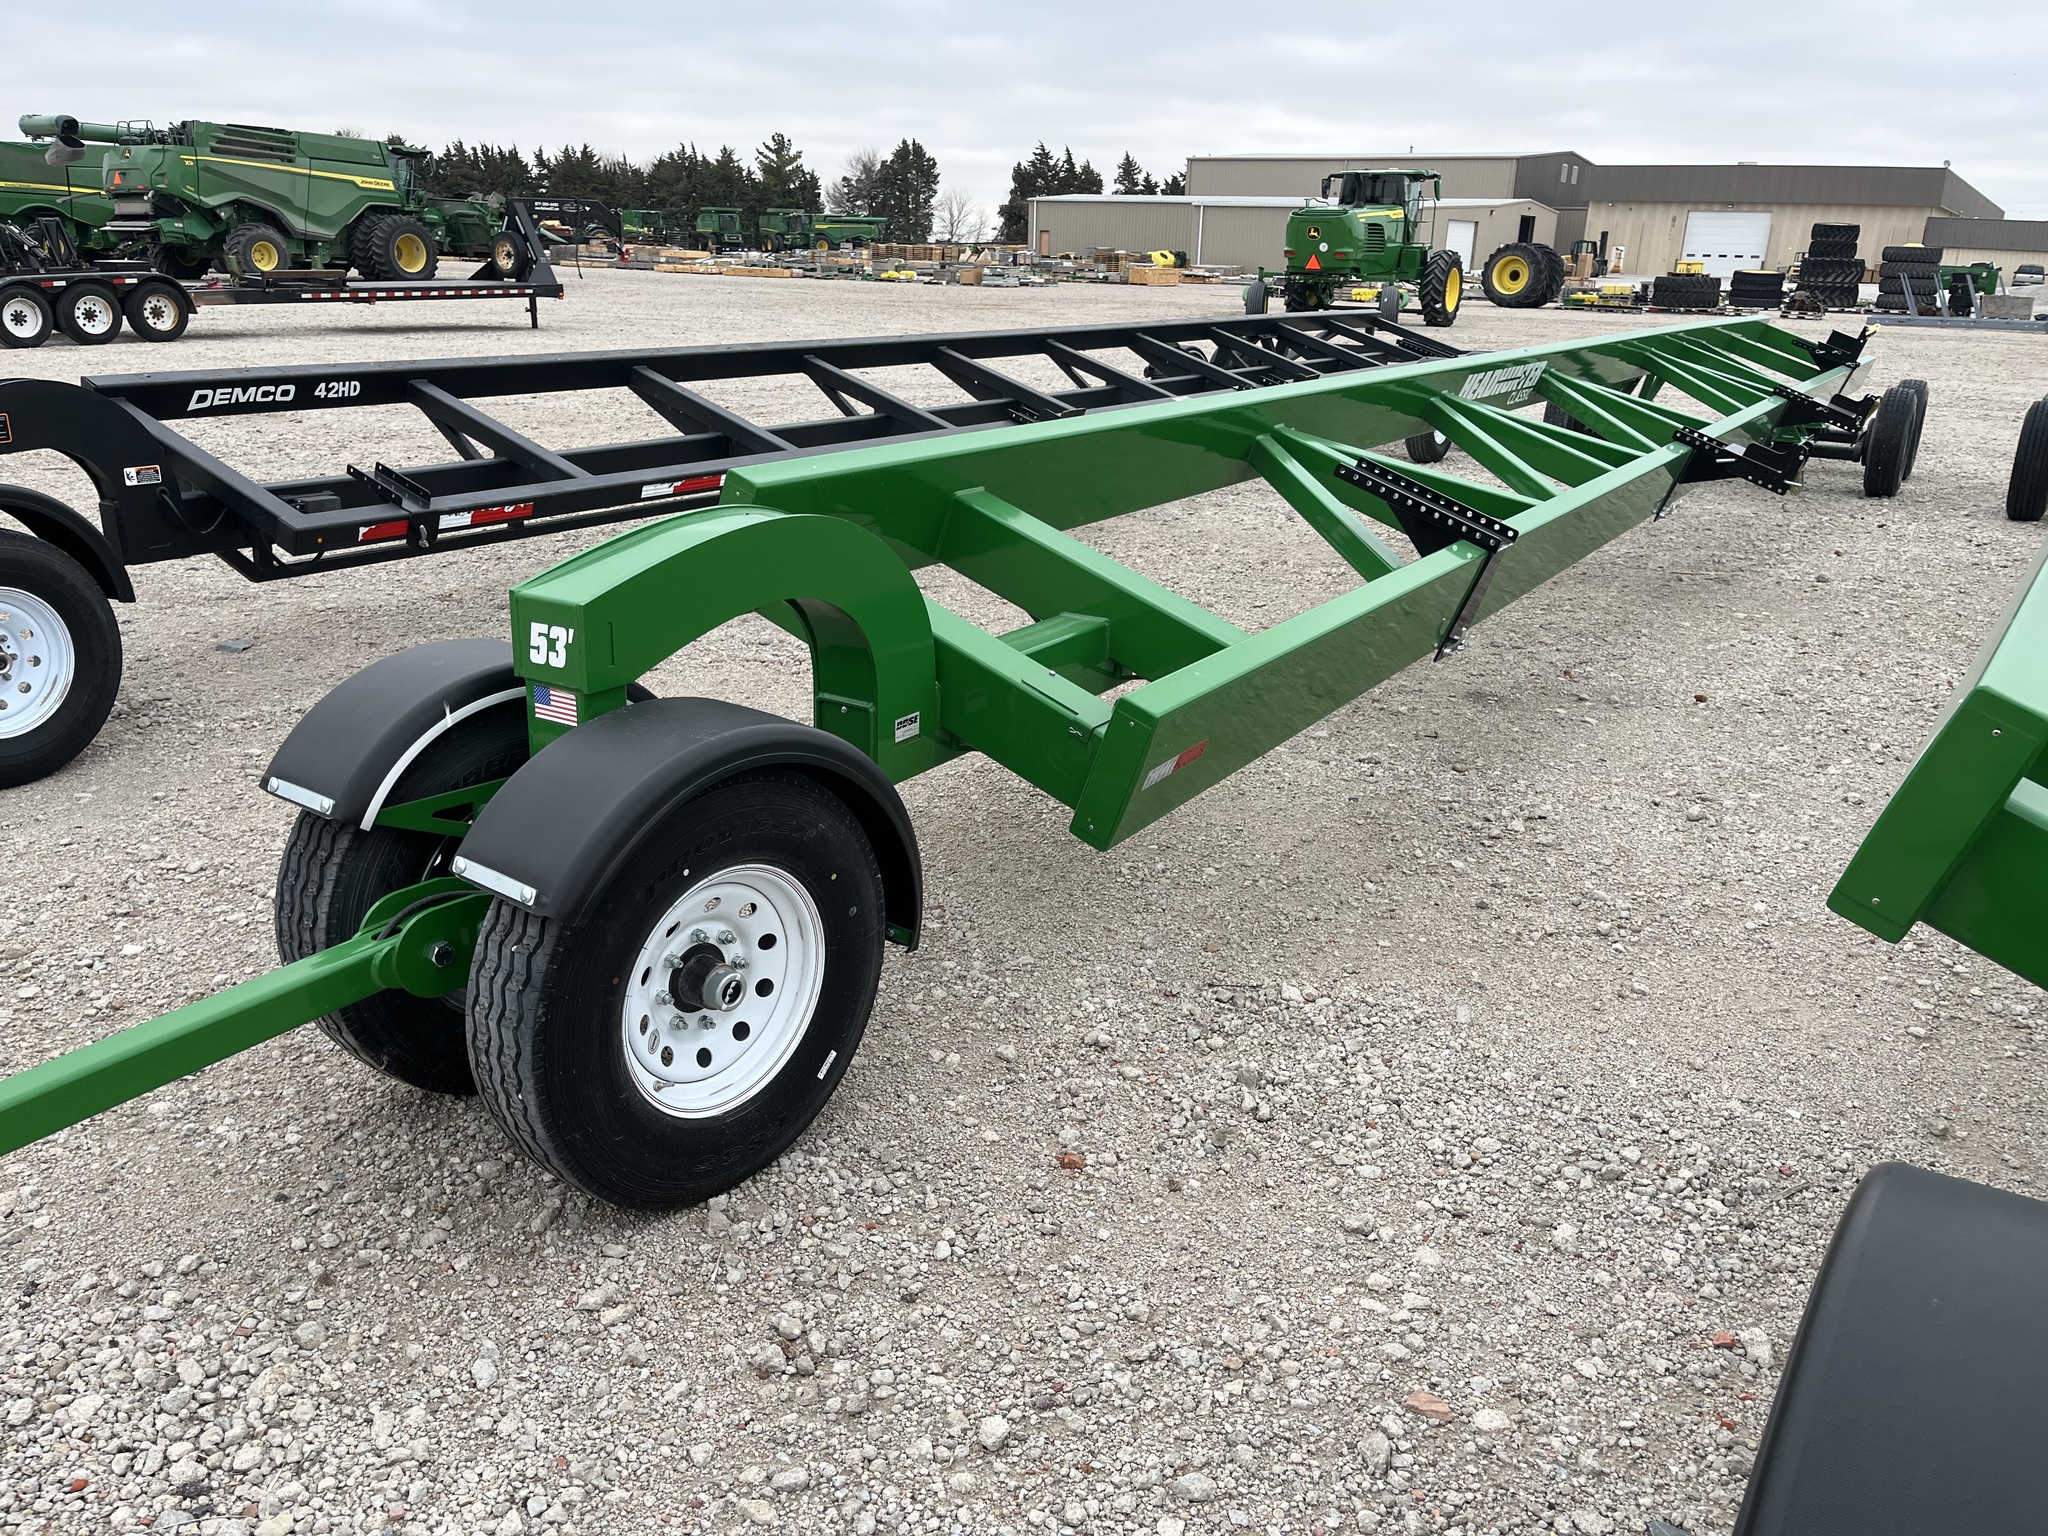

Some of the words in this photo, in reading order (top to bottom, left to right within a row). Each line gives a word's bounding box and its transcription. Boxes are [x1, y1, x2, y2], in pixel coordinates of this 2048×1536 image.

[187, 384, 296, 412] DEMCO
[314, 381, 361, 399] 42HD
[1458, 361, 1548, 400] HEADHUNTER
[1507, 387, 1533, 405] CLASSIC
[529, 621, 575, 669] 53'
[645, 815, 818, 905] PROVIDER
